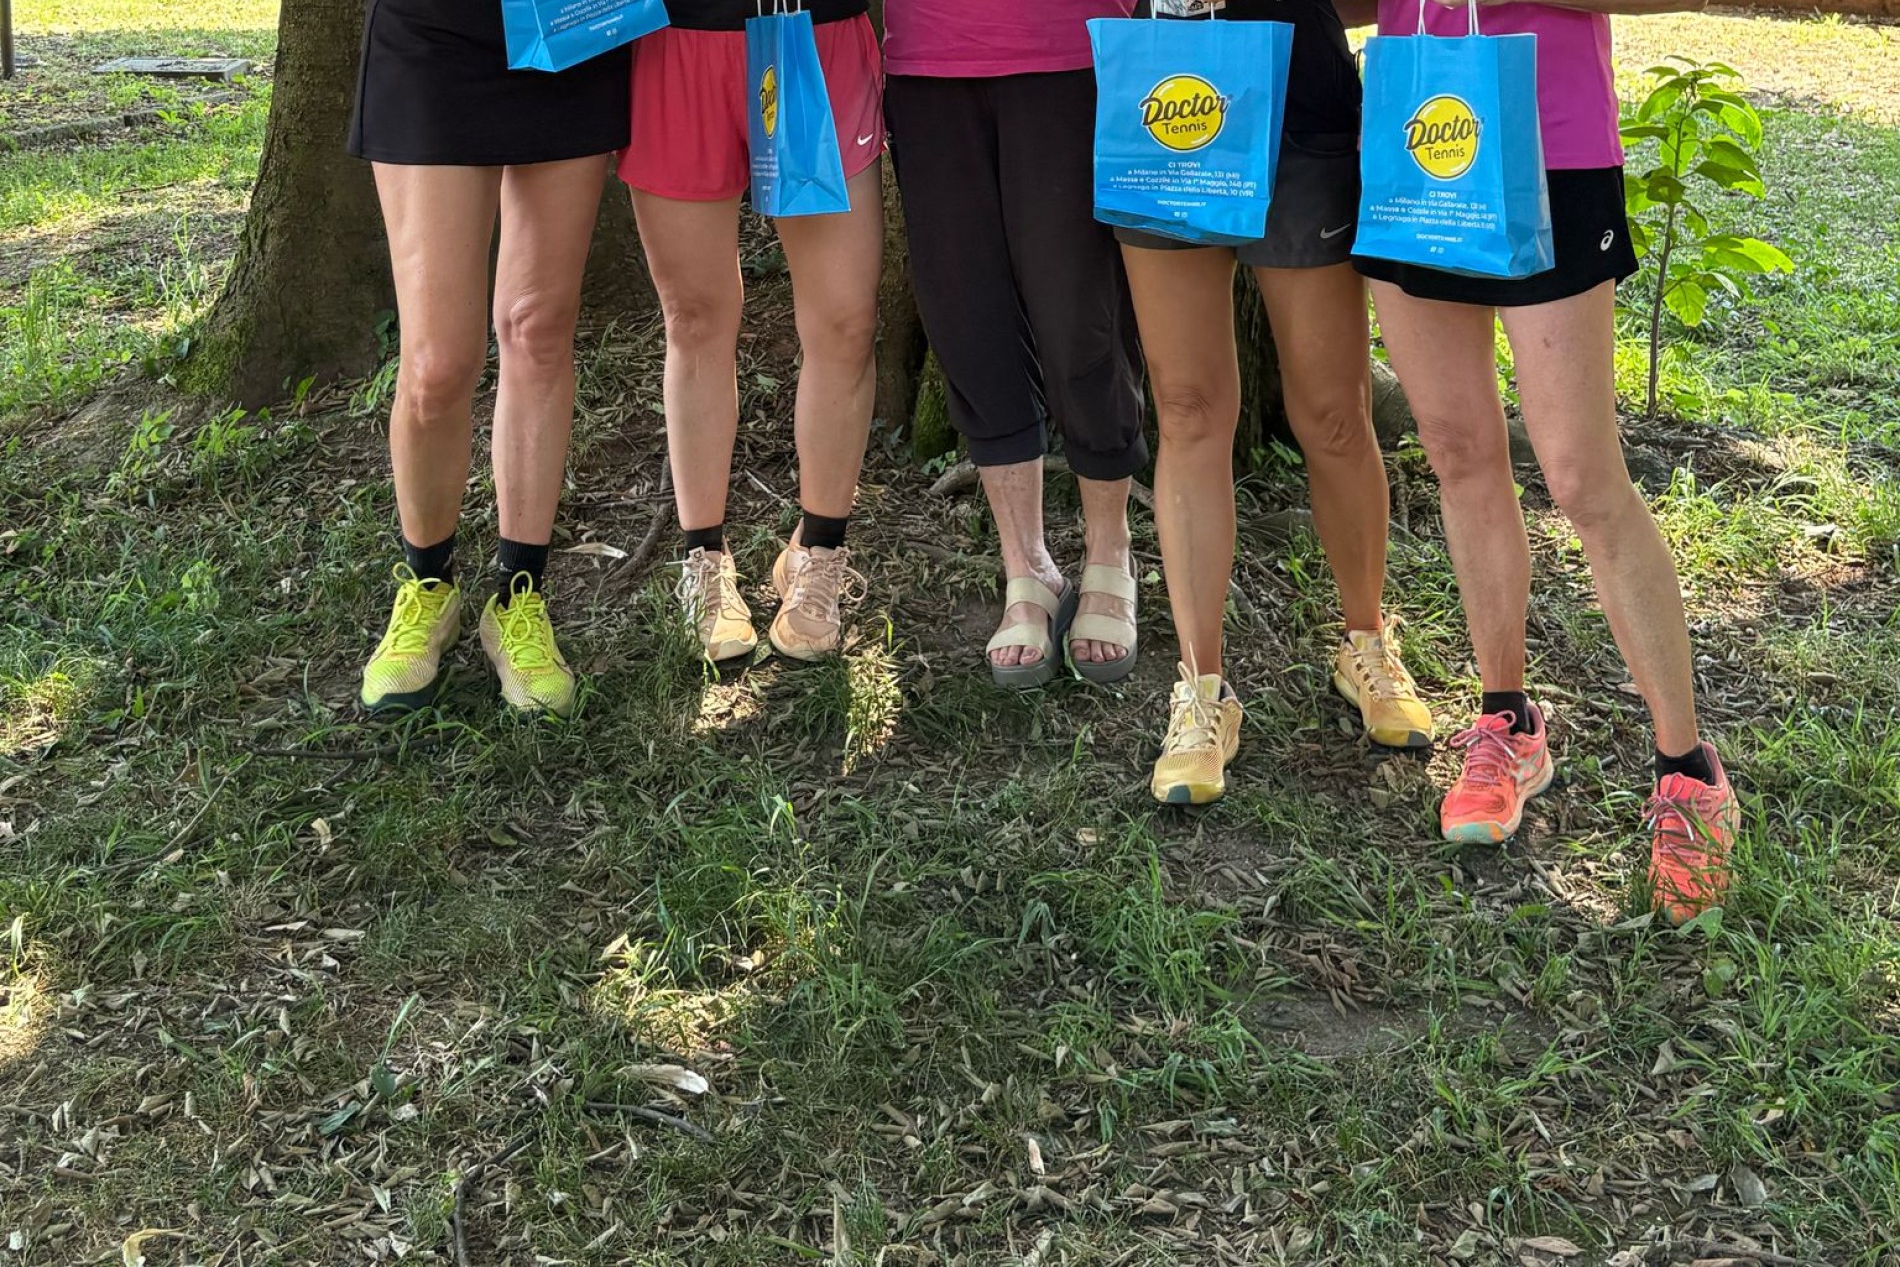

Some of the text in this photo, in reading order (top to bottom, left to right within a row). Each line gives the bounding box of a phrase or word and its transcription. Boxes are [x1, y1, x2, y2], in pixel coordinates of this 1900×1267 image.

[1139, 93, 1229, 126] Doctor
[1162, 119, 1208, 135] Tennis
[1404, 115, 1482, 150] Doctor
[1425, 144, 1466, 160] Tennis
[1133, 168, 1158, 176] Milano
